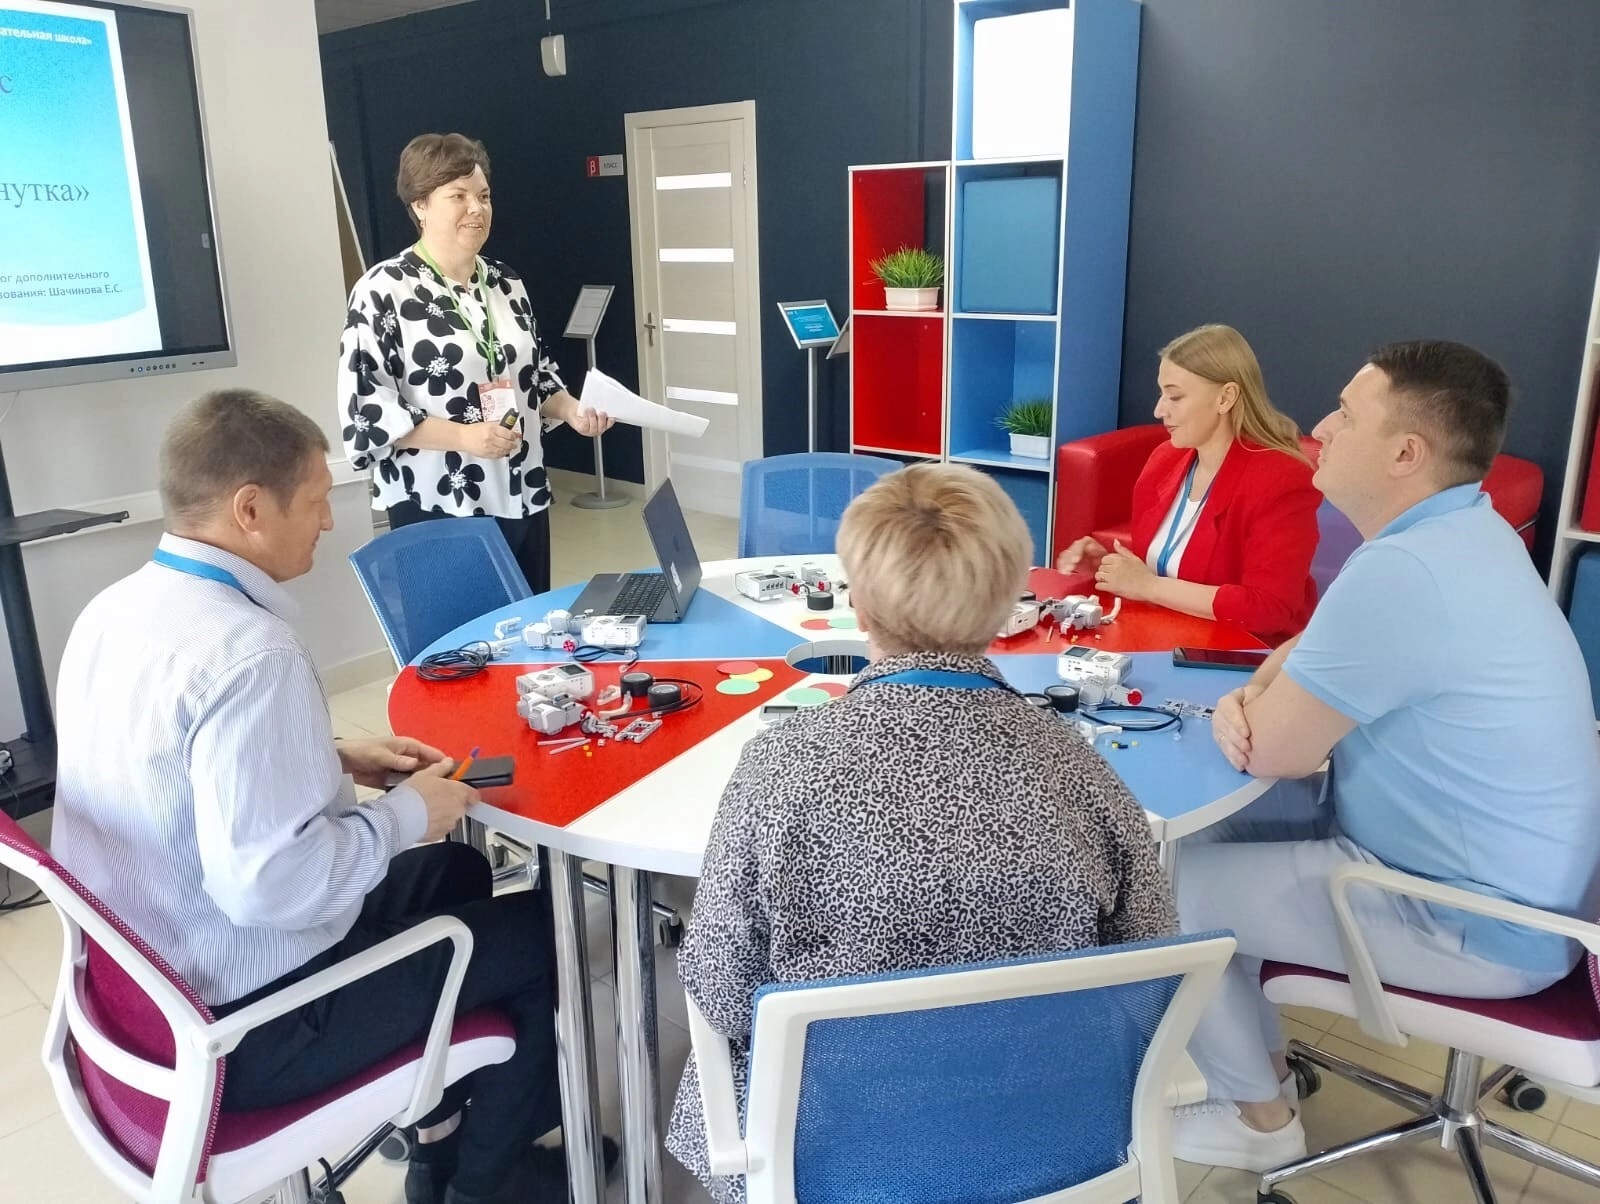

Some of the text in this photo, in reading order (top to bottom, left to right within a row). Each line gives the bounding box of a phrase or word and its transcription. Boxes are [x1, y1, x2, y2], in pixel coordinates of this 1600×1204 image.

[0, 183, 89, 208] нутка»
[16, 271, 110, 284] дополнительного
[49, 285, 102, 297] Шачинова
